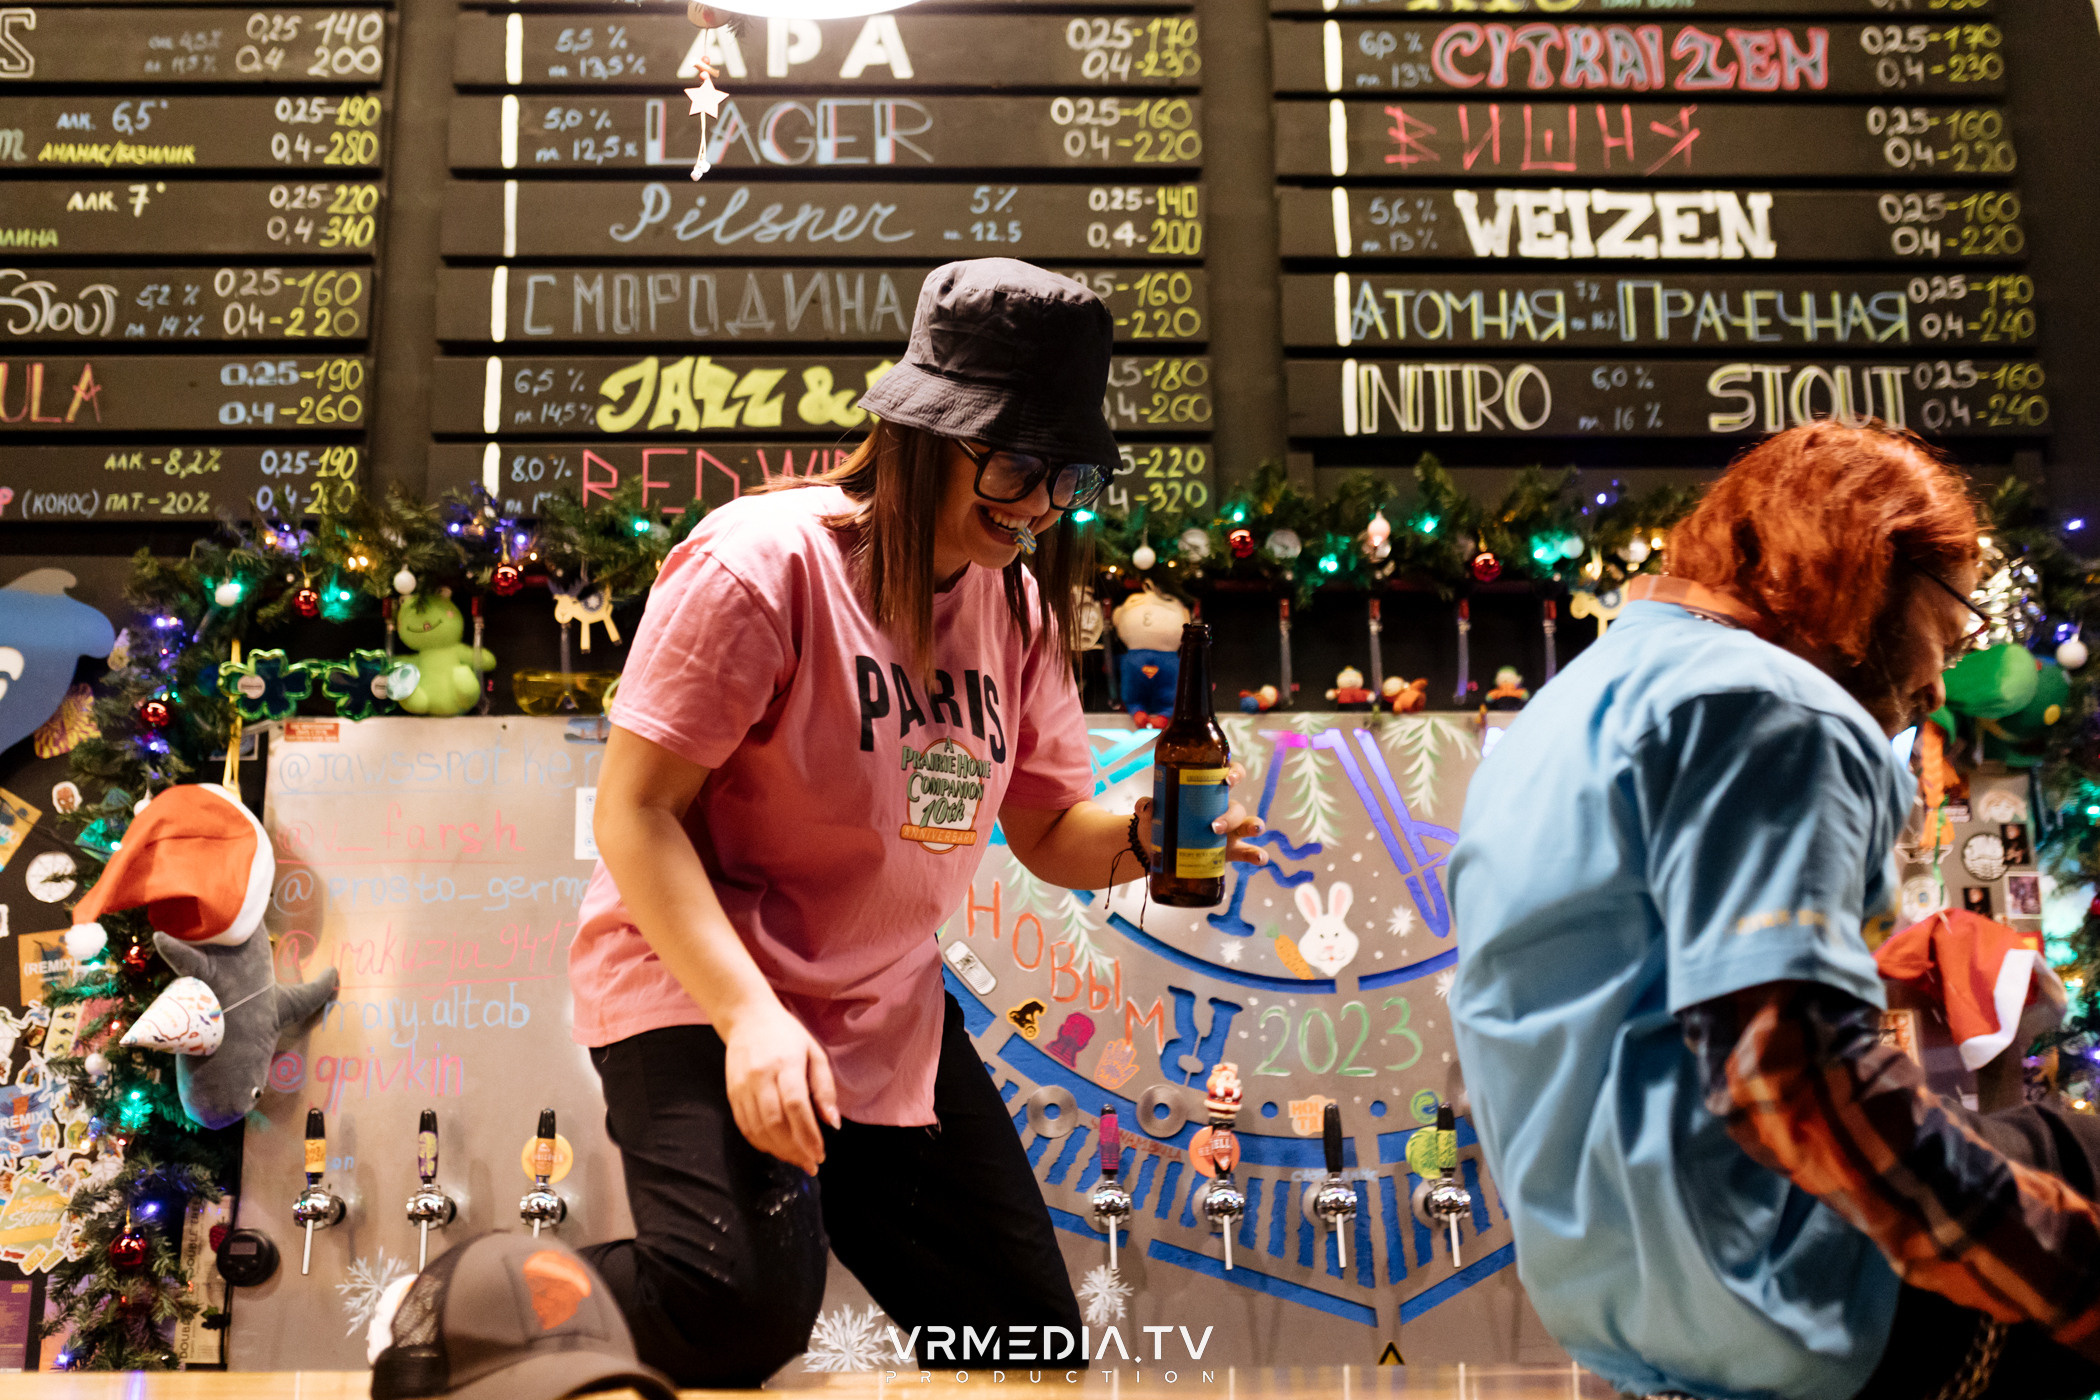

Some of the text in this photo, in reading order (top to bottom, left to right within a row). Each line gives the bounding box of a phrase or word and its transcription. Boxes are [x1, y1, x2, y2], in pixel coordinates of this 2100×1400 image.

[314, 11, 384, 46] 140
[677, 15, 914, 79] APA
[307, 44, 383, 77] 200
[645, 100, 934, 165] LAGER
[609, 183, 916, 245] Pilsner
[1453, 188, 1777, 260] WEIZEN
[523, 271, 909, 337] СМОРОДИНА
[1351, 280, 1567, 342] АТОМНАЯ
[1618, 280, 1910, 343] ПРАЧЕЧНАЯ
[596, 355, 788, 433] JAZZ
[1359, 363, 1552, 434] NITRO
[1707, 362, 1911, 433] STOUT
[582, 449, 741, 516] RED
[856, 655, 1006, 764] PARIS
[901, 745, 991, 779] PRAIRIE HOME
[943, 736, 955, 753] A
[907, 771, 984, 803] COMPANION
[919, 796, 965, 828] 10th
[903, 829, 976, 843] ANNIVERSARY
[1252, 996, 1424, 1077] 2023
